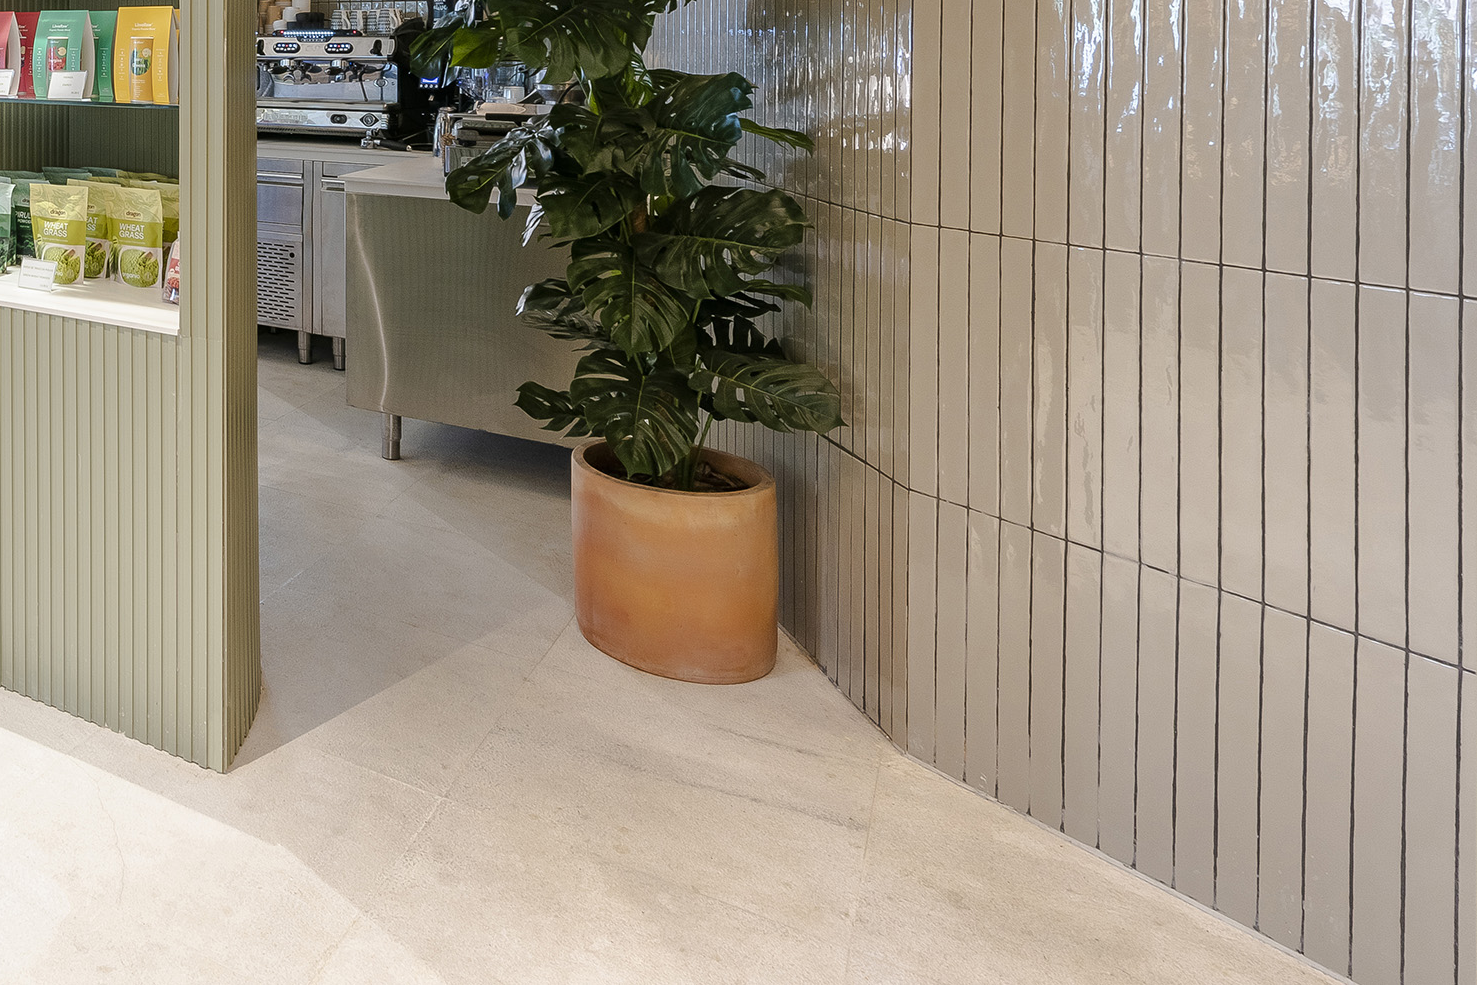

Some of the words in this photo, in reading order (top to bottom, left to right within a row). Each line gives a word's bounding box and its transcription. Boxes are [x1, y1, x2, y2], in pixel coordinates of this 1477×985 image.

[44, 221, 68, 230] WHEAT
[119, 223, 144, 232] WHEAT
[43, 228, 67, 238] GRASS
[119, 231, 144, 239] GRASS
